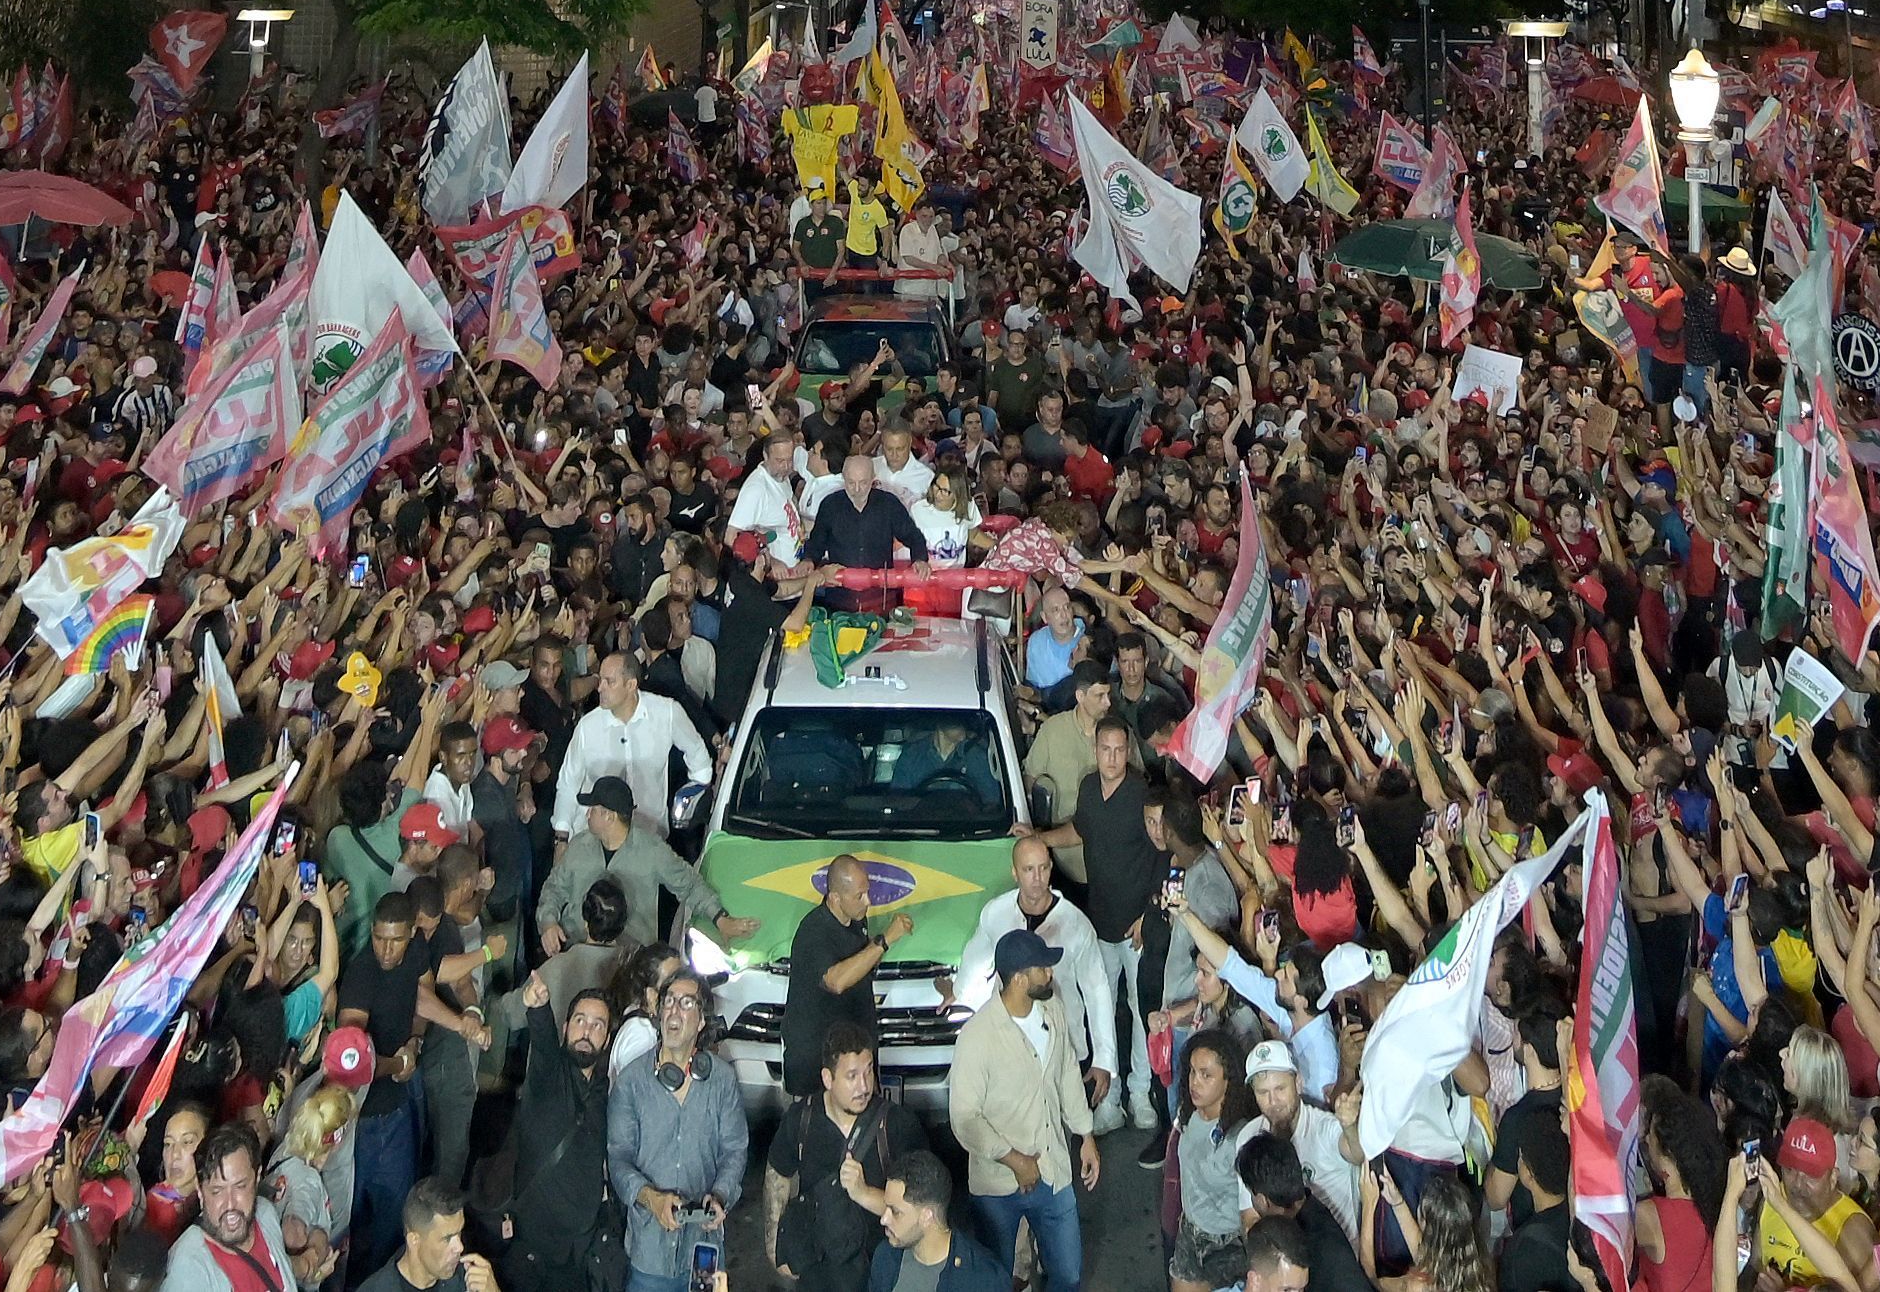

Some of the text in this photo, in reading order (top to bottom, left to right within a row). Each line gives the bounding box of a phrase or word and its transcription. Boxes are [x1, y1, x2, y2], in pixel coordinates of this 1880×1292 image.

[1026, 2, 1053, 15] BORA
[1026, 50, 1051, 62] LULA
[1791, 1134, 1817, 1155] LULA
